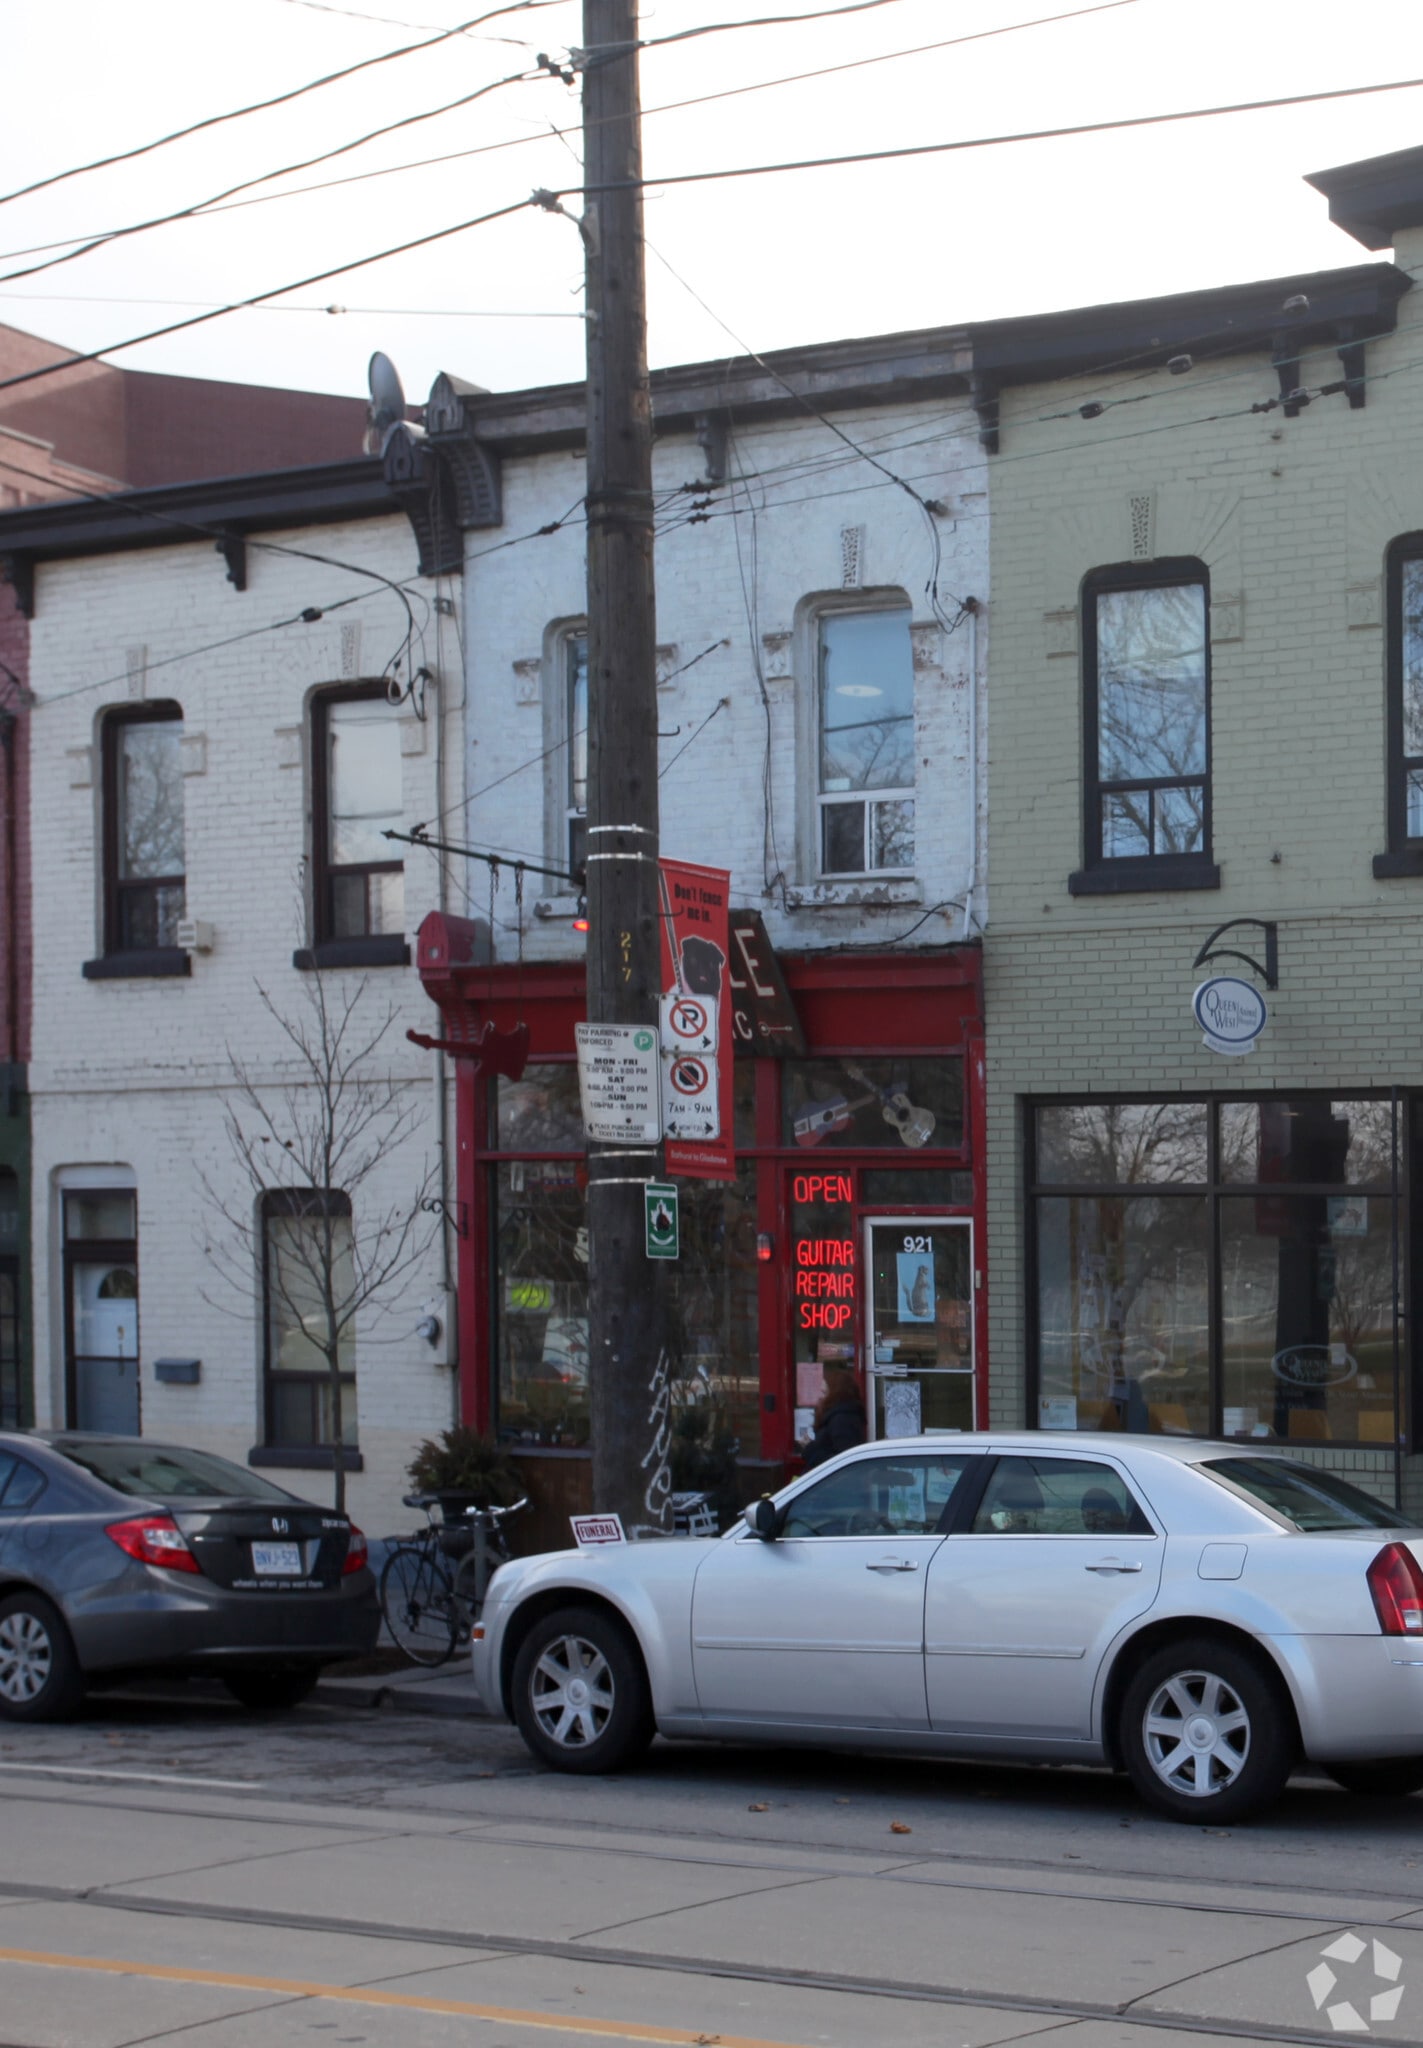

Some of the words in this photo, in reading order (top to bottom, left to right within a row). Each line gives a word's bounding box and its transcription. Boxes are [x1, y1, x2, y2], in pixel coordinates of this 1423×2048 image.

[674, 883, 697, 902] Don't
[687, 906, 700, 921] me
[1206, 989, 1237, 1017] QUEEN
[1214, 1009, 1236, 1029] WEST
[590, 1029, 622, 1037] PARKING
[579, 1037, 613, 1046] ENFORCED
[594, 1057, 616, 1065] MON
[623, 1058, 638, 1066] FRI
[636, 1067, 648, 1075] PM
[608, 1076, 625, 1084] SAT
[608, 1094, 627, 1102] SUN
[636, 1103, 648, 1111] PM
[668, 1102, 686, 1113] 7AM
[694, 1103, 712, 1114] 9AM
[794, 1175, 853, 1203] OPEN
[903, 1236, 933, 1253] 921
[796, 1239, 855, 1267] GUITAR
[796, 1270, 855, 1298] REPAIR
[800, 1302, 851, 1330] SHOP
[580, 1523, 617, 1538] FUNERAL
[232, 1579, 258, 1588] wheels
[259, 1579, 278, 1588] when
[278, 1580, 291, 1590] you
